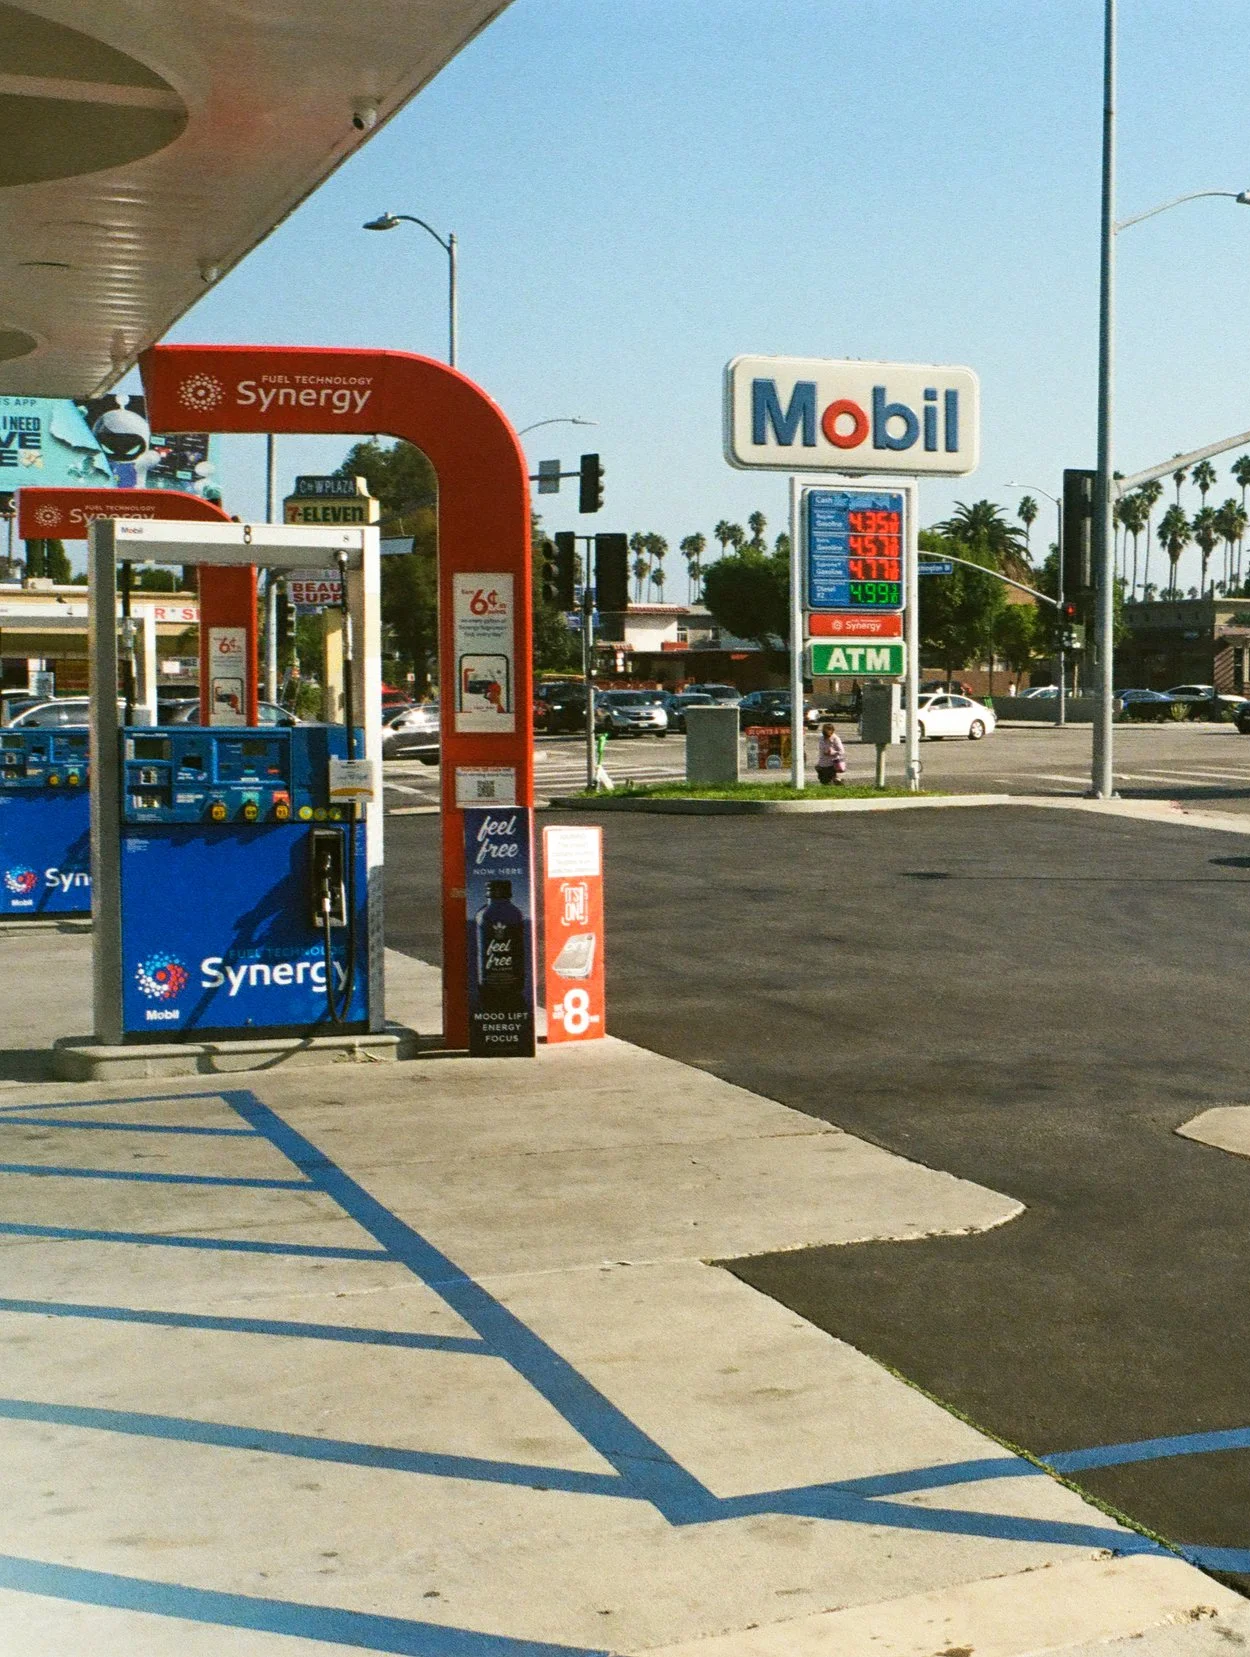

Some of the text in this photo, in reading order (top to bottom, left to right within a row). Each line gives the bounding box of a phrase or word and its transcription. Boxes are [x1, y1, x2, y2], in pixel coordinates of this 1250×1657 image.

[262, 375, 373, 386] FUEL TECHNOLOGY
[15, 399, 37, 407] APP
[237, 381, 372, 414] Synergy
[752, 378, 958, 453] Mobil
[10, 416, 41, 431] NEED
[325, 480, 354, 493] PLAZA
[292, 583, 342, 592] BEAU
[293, 593, 342, 602] SUPP
[846, 620, 881, 632] Synergy
[827, 648, 891, 671] ATM
[477, 815, 516, 842] feel
[475, 838, 519, 864] free
[498, 867, 523, 875] HERE
[267, 945, 348, 957] TECHNOLOG
[486, 939, 511, 956] feel
[485, 953, 512, 970] free
[201, 956, 352, 997] Synergy
[146, 1009, 180, 1020] Mobil
[474, 1012, 528, 1021] MOOD LIFT
[482, 1023, 520, 1031] ENERGY
[485, 1035, 519, 1043] FOCUS
